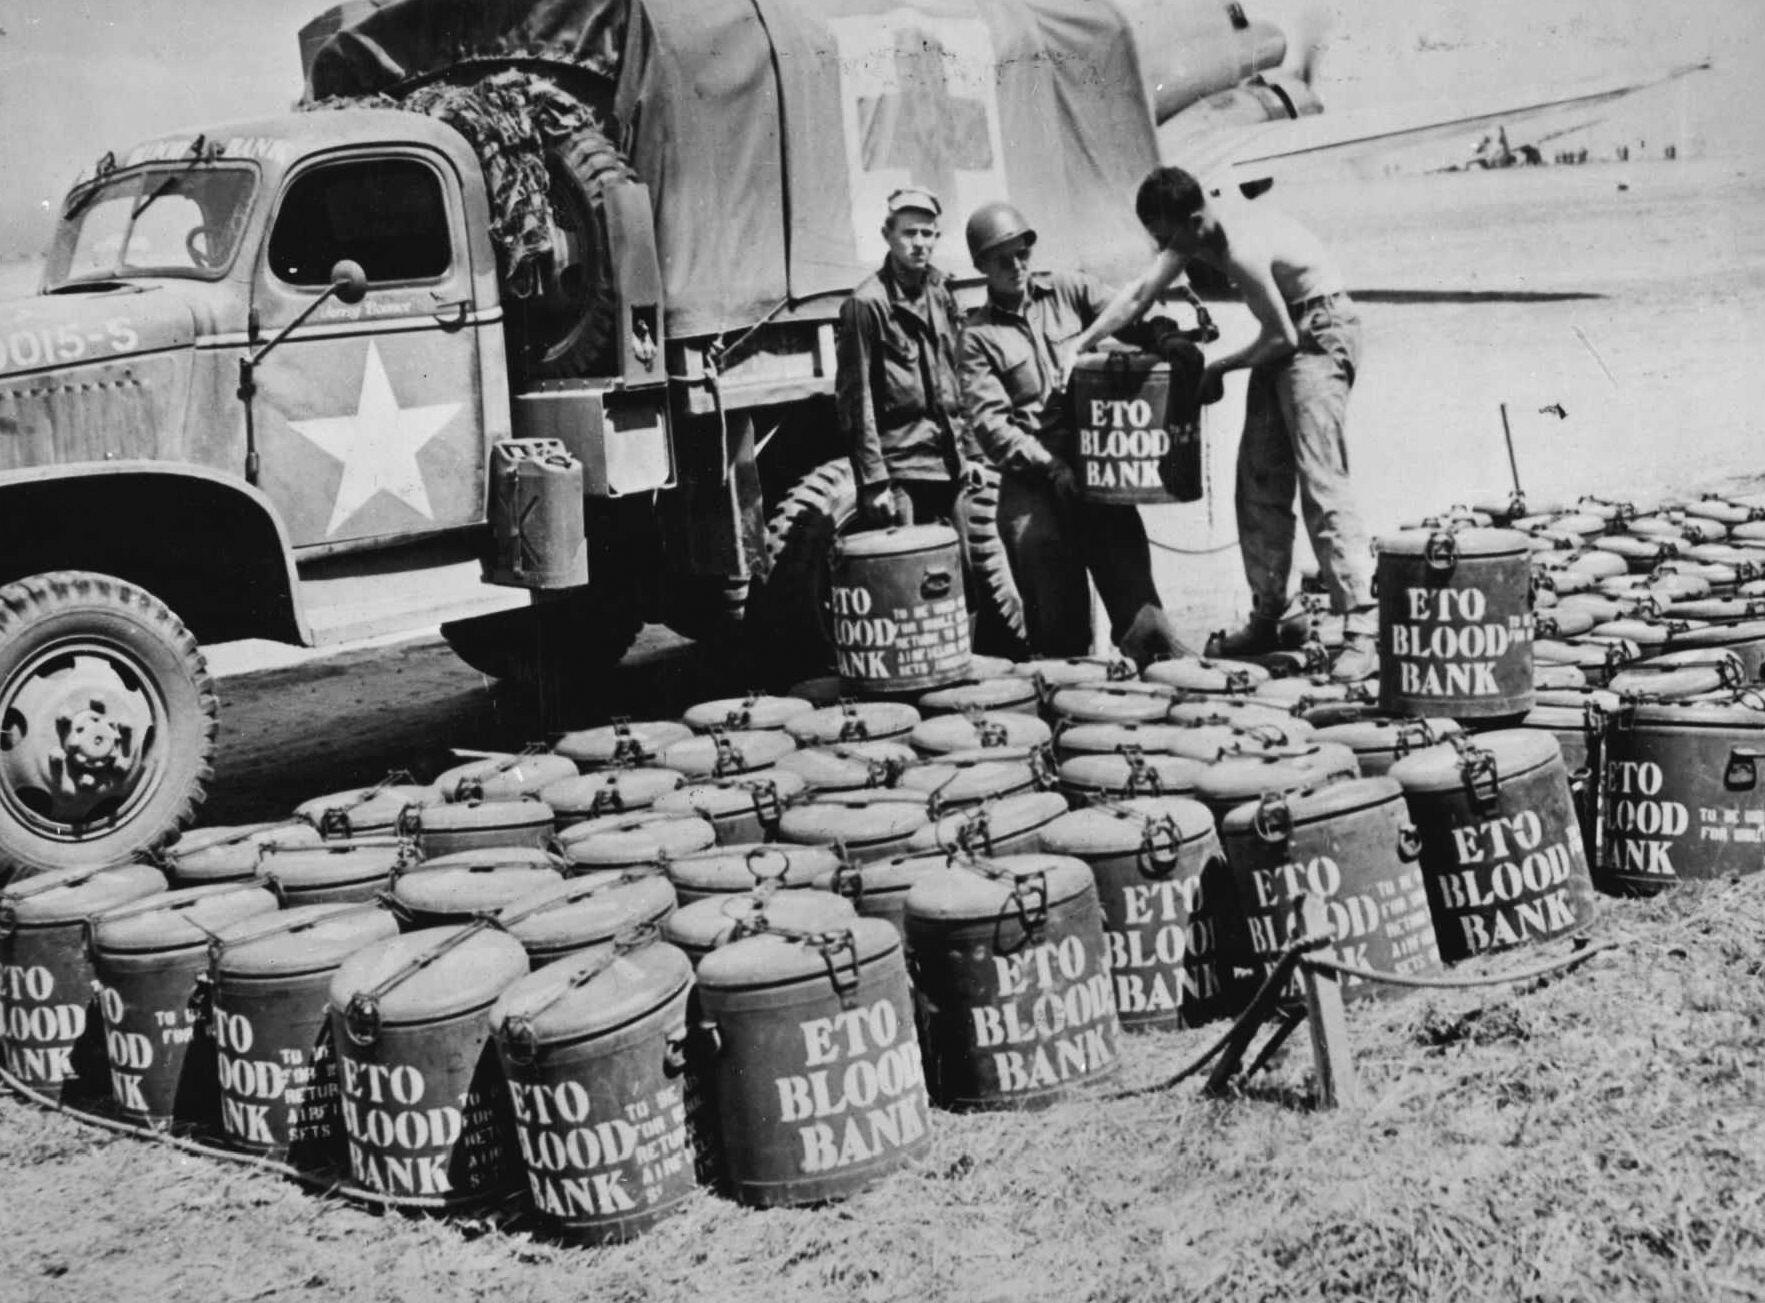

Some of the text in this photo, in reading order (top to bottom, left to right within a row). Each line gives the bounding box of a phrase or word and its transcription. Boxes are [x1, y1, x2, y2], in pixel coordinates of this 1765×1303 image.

[0, 318, 139, 369] 015-S
[1091, 399, 1152, 428] ETO
[1080, 428, 1170, 458] BLOOD
[1086, 459, 1163, 488] BANK
[1407, 588, 1486, 621] ETO
[834, 618, 896, 646] LOOD
[1392, 624, 1508, 658] BLOOD
[837, 650, 891, 678] ANK
[1401, 662, 1499, 696] BANK
[1451, 810, 1542, 864] ETO
[1606, 800, 1689, 836] LOOD
[1438, 843, 1570, 908] BLOOD
[1611, 839, 1676, 875] ANK
[1122, 876, 1203, 925] ETO
[1253, 856, 1340, 907] ETO
[1459, 888, 1576, 951] BANK
[0, 965, 54, 1001] TO
[992, 935, 1086, 997] ETO
[0, 1003, 86, 1041] LOOD
[212, 1004, 253, 1053] TO
[800, 998, 897, 1067] ETO
[971, 974, 1116, 1047] BLOOD
[3, 1045, 76, 1082] ANK
[218, 1052, 284, 1099] OOD
[342, 1055, 425, 1105] ETO
[992, 1024, 1114, 1092] BANK
[507, 1079, 590, 1124] ETO
[775, 1041, 922, 1123] BLOOD
[799, 1092, 925, 1174] BANK
[528, 1169, 637, 1217] BANK
